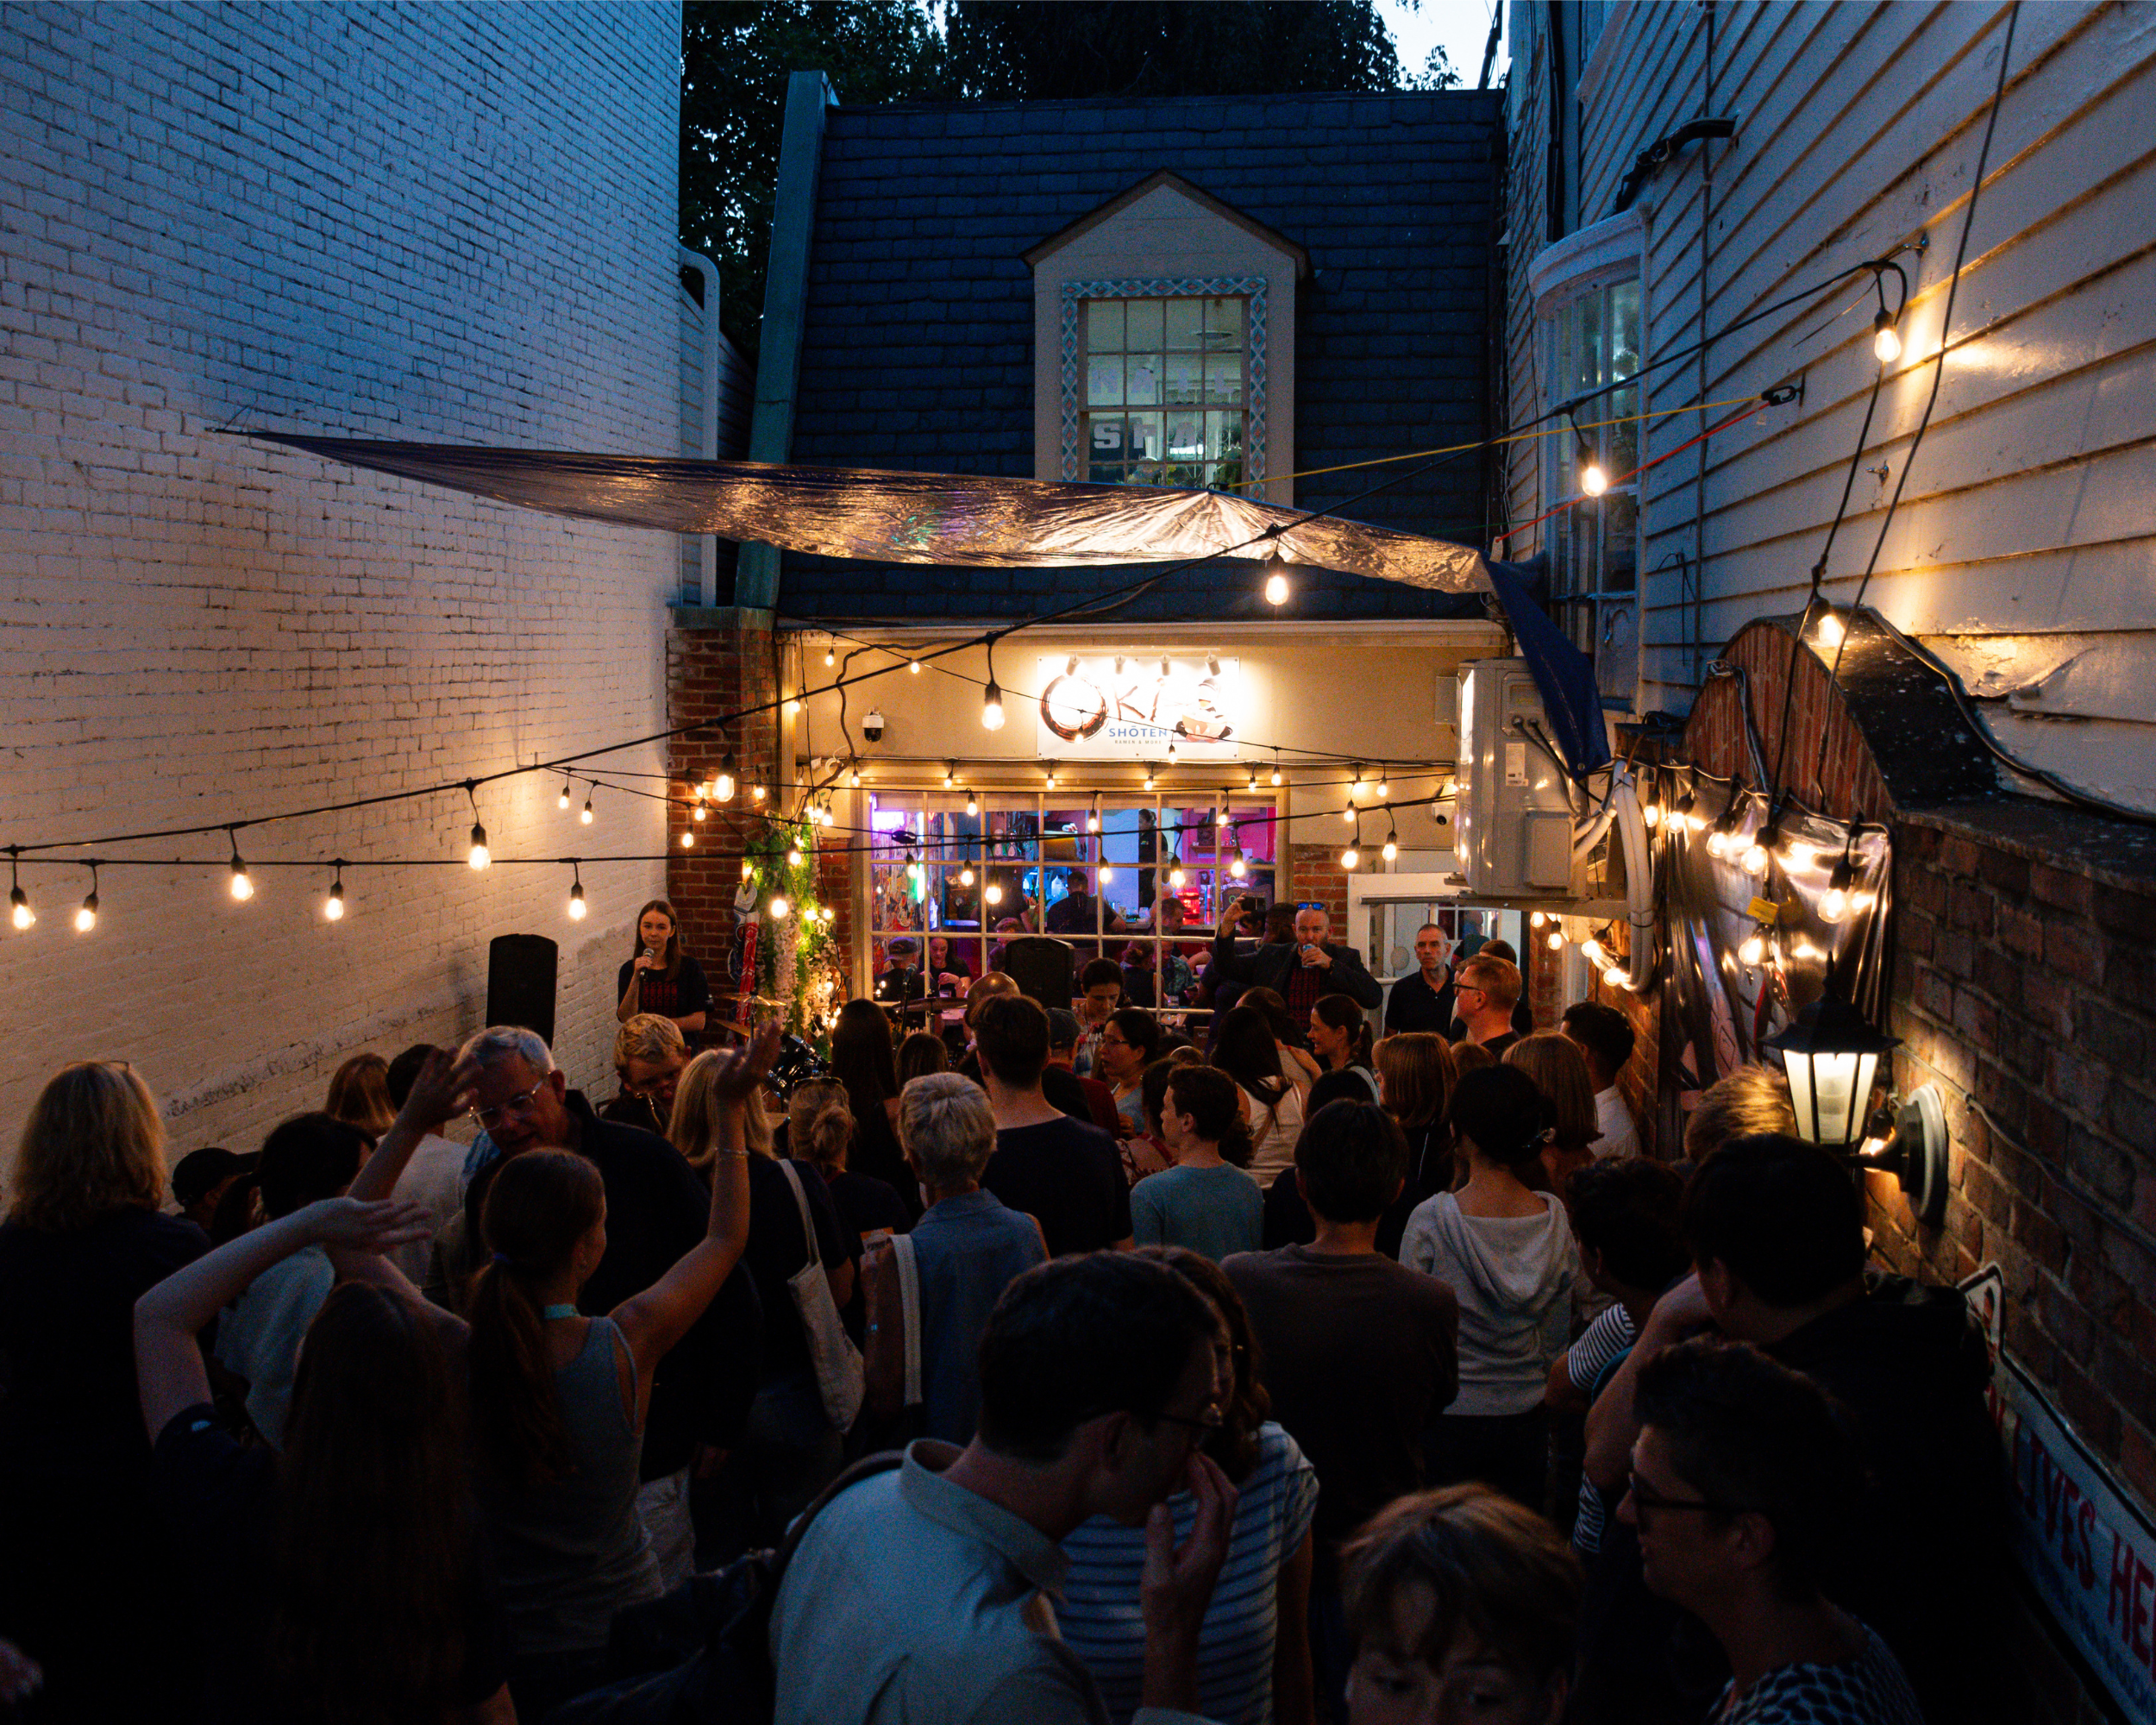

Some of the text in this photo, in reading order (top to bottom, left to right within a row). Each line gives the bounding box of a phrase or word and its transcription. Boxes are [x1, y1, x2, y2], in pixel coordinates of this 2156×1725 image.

[1094, 423, 1196, 448] SPA
[2013, 1414, 2096, 1590] LIVES
[2108, 1530, 2156, 1683] HE
